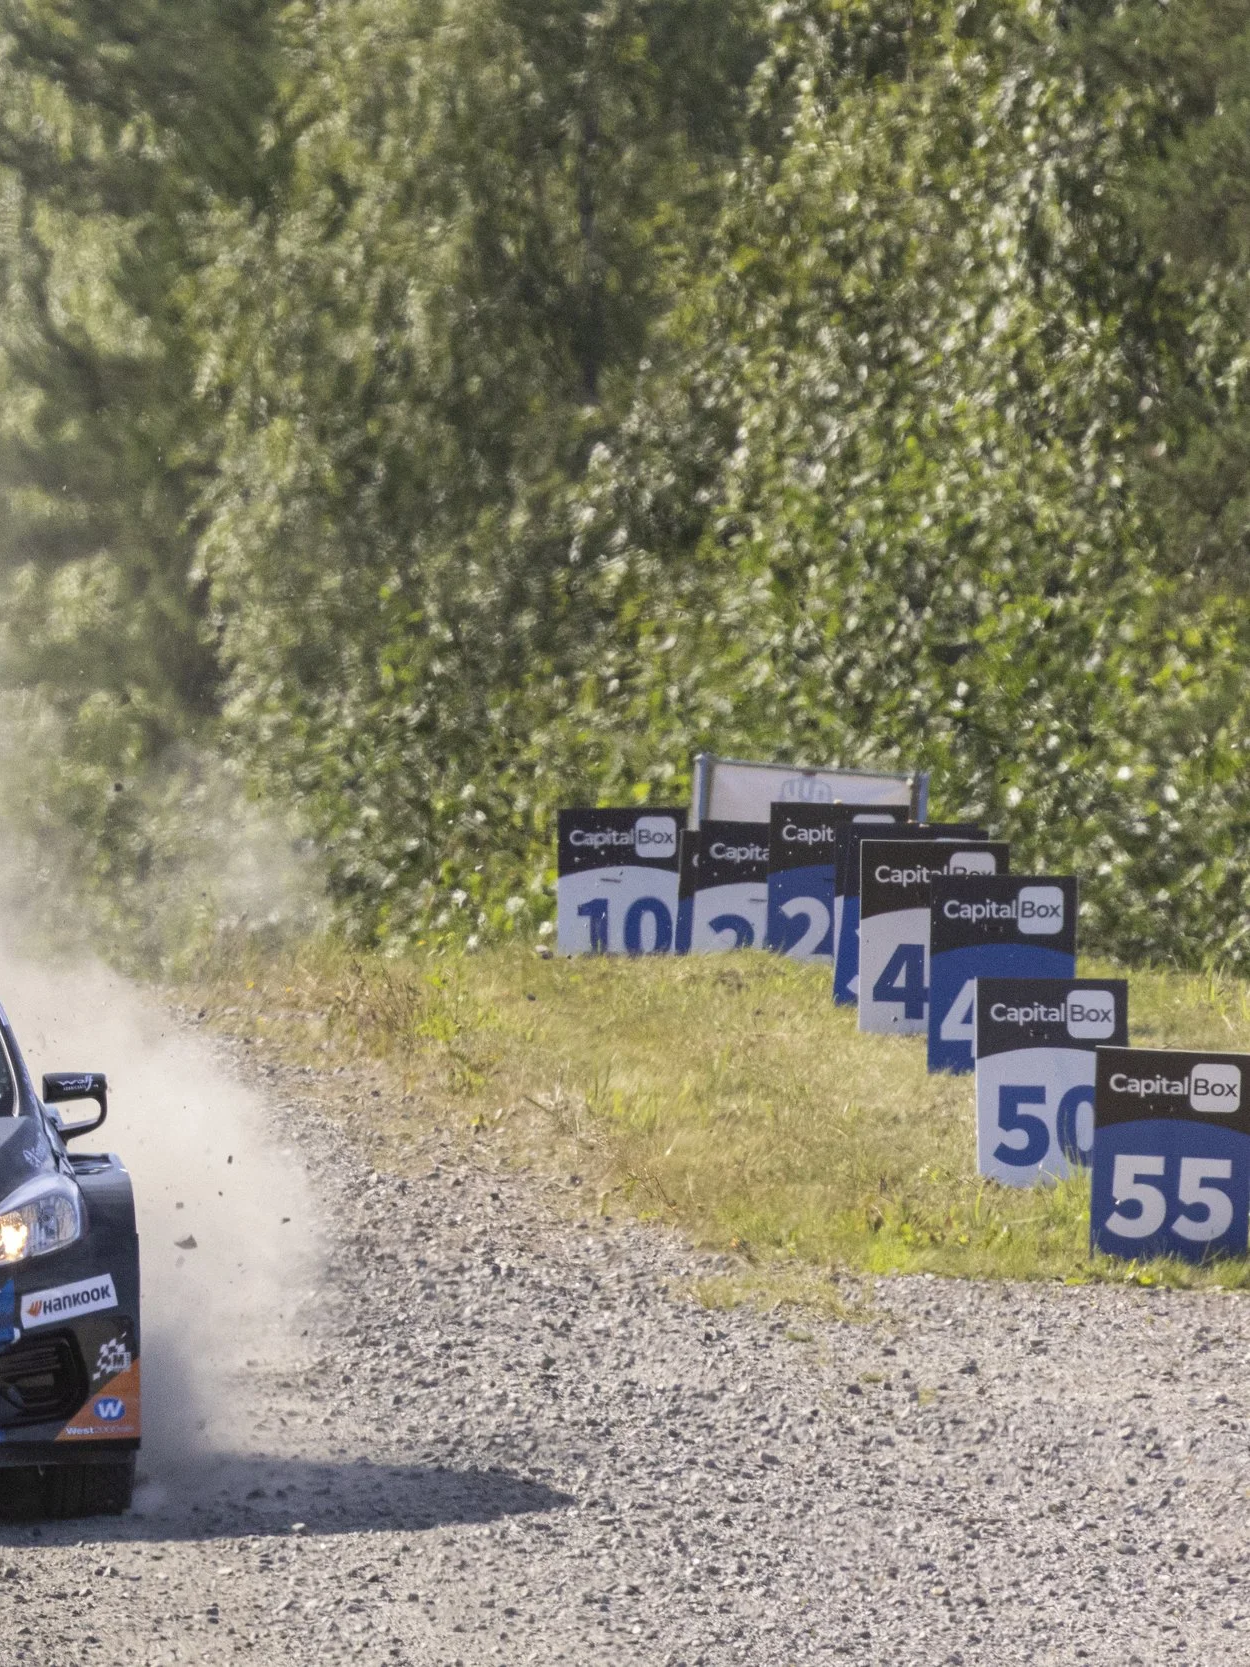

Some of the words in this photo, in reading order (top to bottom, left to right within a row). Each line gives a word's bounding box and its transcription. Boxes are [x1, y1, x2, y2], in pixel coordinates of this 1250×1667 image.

[782, 824, 836, 845] Capit
[577, 896, 674, 954] 10
[781, 896, 833, 959] 2
[872, 943, 929, 1020] 4
[993, 1084, 1095, 1168] 50
[1105, 1154, 1234, 1242] 55
[98, 1401, 123, 1418] W
